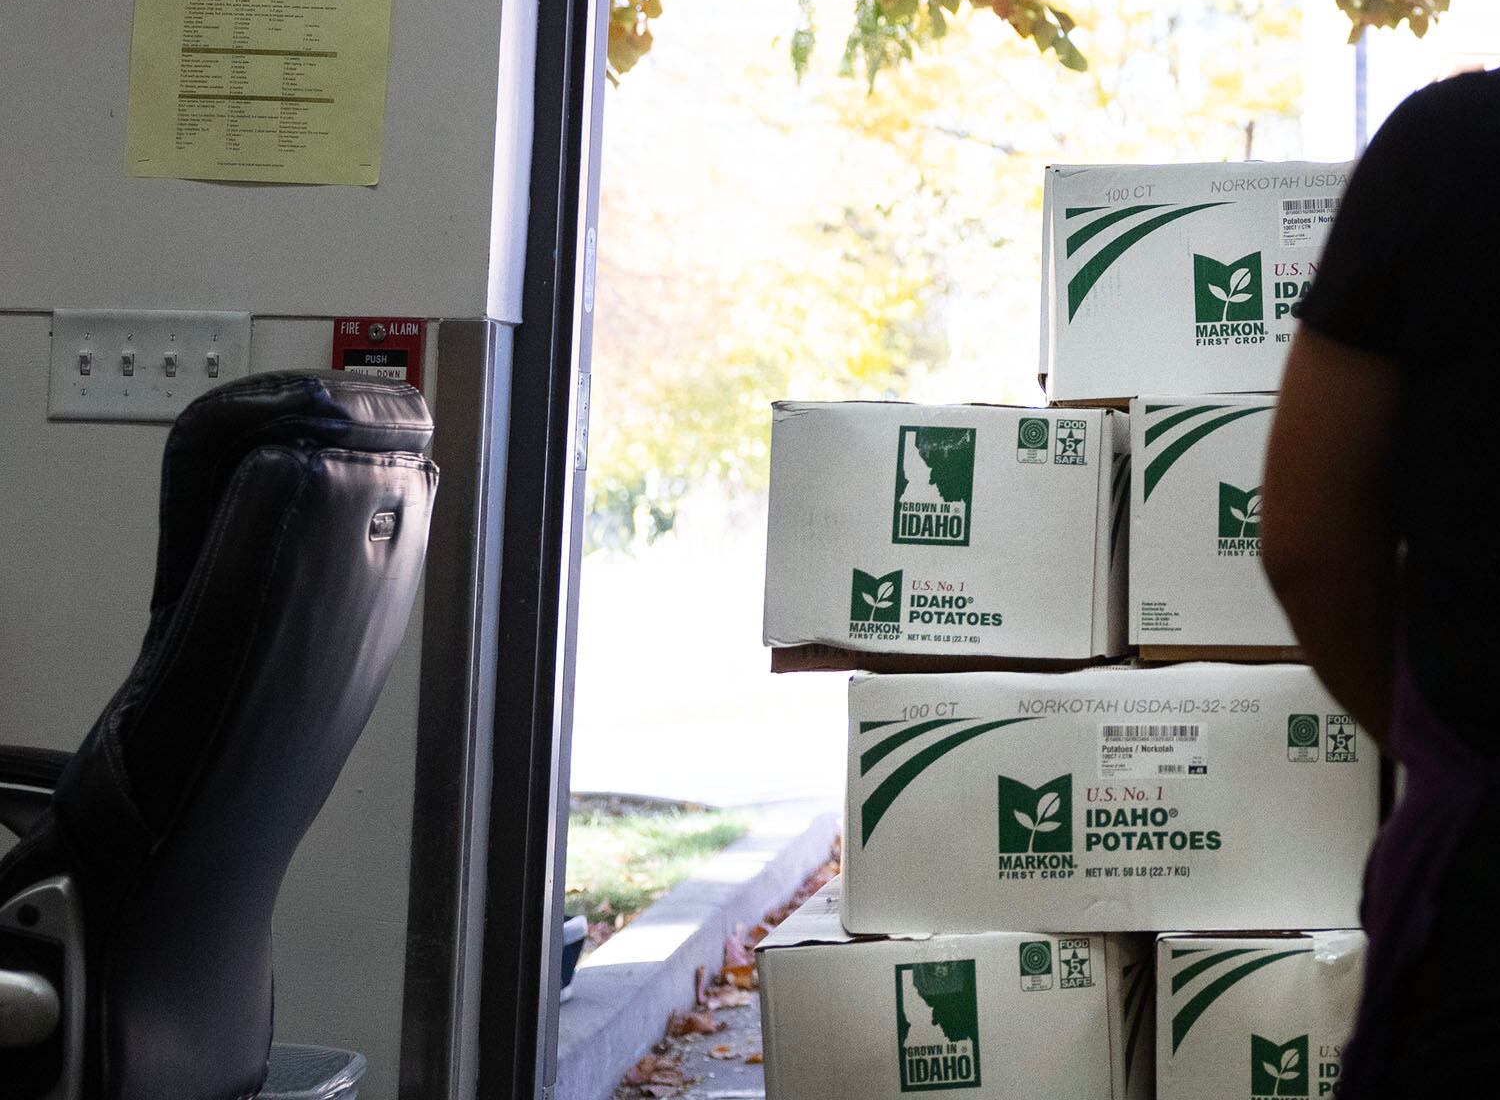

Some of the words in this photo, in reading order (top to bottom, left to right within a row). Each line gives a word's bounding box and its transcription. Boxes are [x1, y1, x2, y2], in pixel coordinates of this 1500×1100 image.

[1104, 188, 1129, 202] 100
[1134, 184, 1155, 198] CT
[1210, 177, 1300, 193] NORKOTAH
[1282, 217, 1311, 225] Potatoes
[1274, 263, 1302, 276] U.S.
[341, 322, 360, 335] FIRE
[389, 322, 419, 335] ALARM
[1195, 322, 1264, 337] MARKON
[1196, 338, 1229, 346] FIRST
[1235, 336, 1265, 345] CROP
[1276, 333, 1291, 342] NET
[365, 354, 387, 364] PUSH
[377, 370, 400, 379] DOWN
[1057, 420, 1085, 428] FOOD
[1065, 438, 1075, 451] 5
[1055, 456, 1083, 464] SAFE
[902, 501, 937, 512] GROWN
[940, 503, 951, 513] IN
[901, 513, 962, 538] IDAHO
[912, 580, 933, 591] U.S.
[937, 581, 955, 592] No.
[960, 582, 964, 592] 1
[909, 610, 1003, 626] POTATOES
[902, 704, 930, 721] 100
[935, 702, 958, 717] CT
[1018, 699, 1118, 714] NORKOTAH
[1336, 734, 1346, 747] 5
[1102, 745, 1133, 753] Potatoes
[1141, 745, 1174, 753] Norkotah
[1327, 753, 1354, 762] SAFE
[1087, 787, 1117, 802] U.S.
[1123, 788, 1149, 801] No.
[1156, 786, 1163, 800] 1
[1086, 830, 1222, 852] POTATOES
[999, 870, 1034, 879] FIRST
[1041, 870, 1074, 879] CROP
[1086, 867, 1102, 877] NET
[1104, 867, 1120, 877] WT.
[1122, 867, 1133, 877] 50
[1136, 866, 1147, 877] LB
[1149, 866, 1172, 878] (22.7
[1174, 866, 1190, 878] KG)
[1060, 940, 1089, 949] FOOD
[1070, 958, 1081, 972] 5
[1062, 979, 1090, 988] SAFE
[907, 1044, 943, 1058] GROWN
[946, 1044, 957, 1054] IN
[908, 1055, 972, 1084] IDAHO
